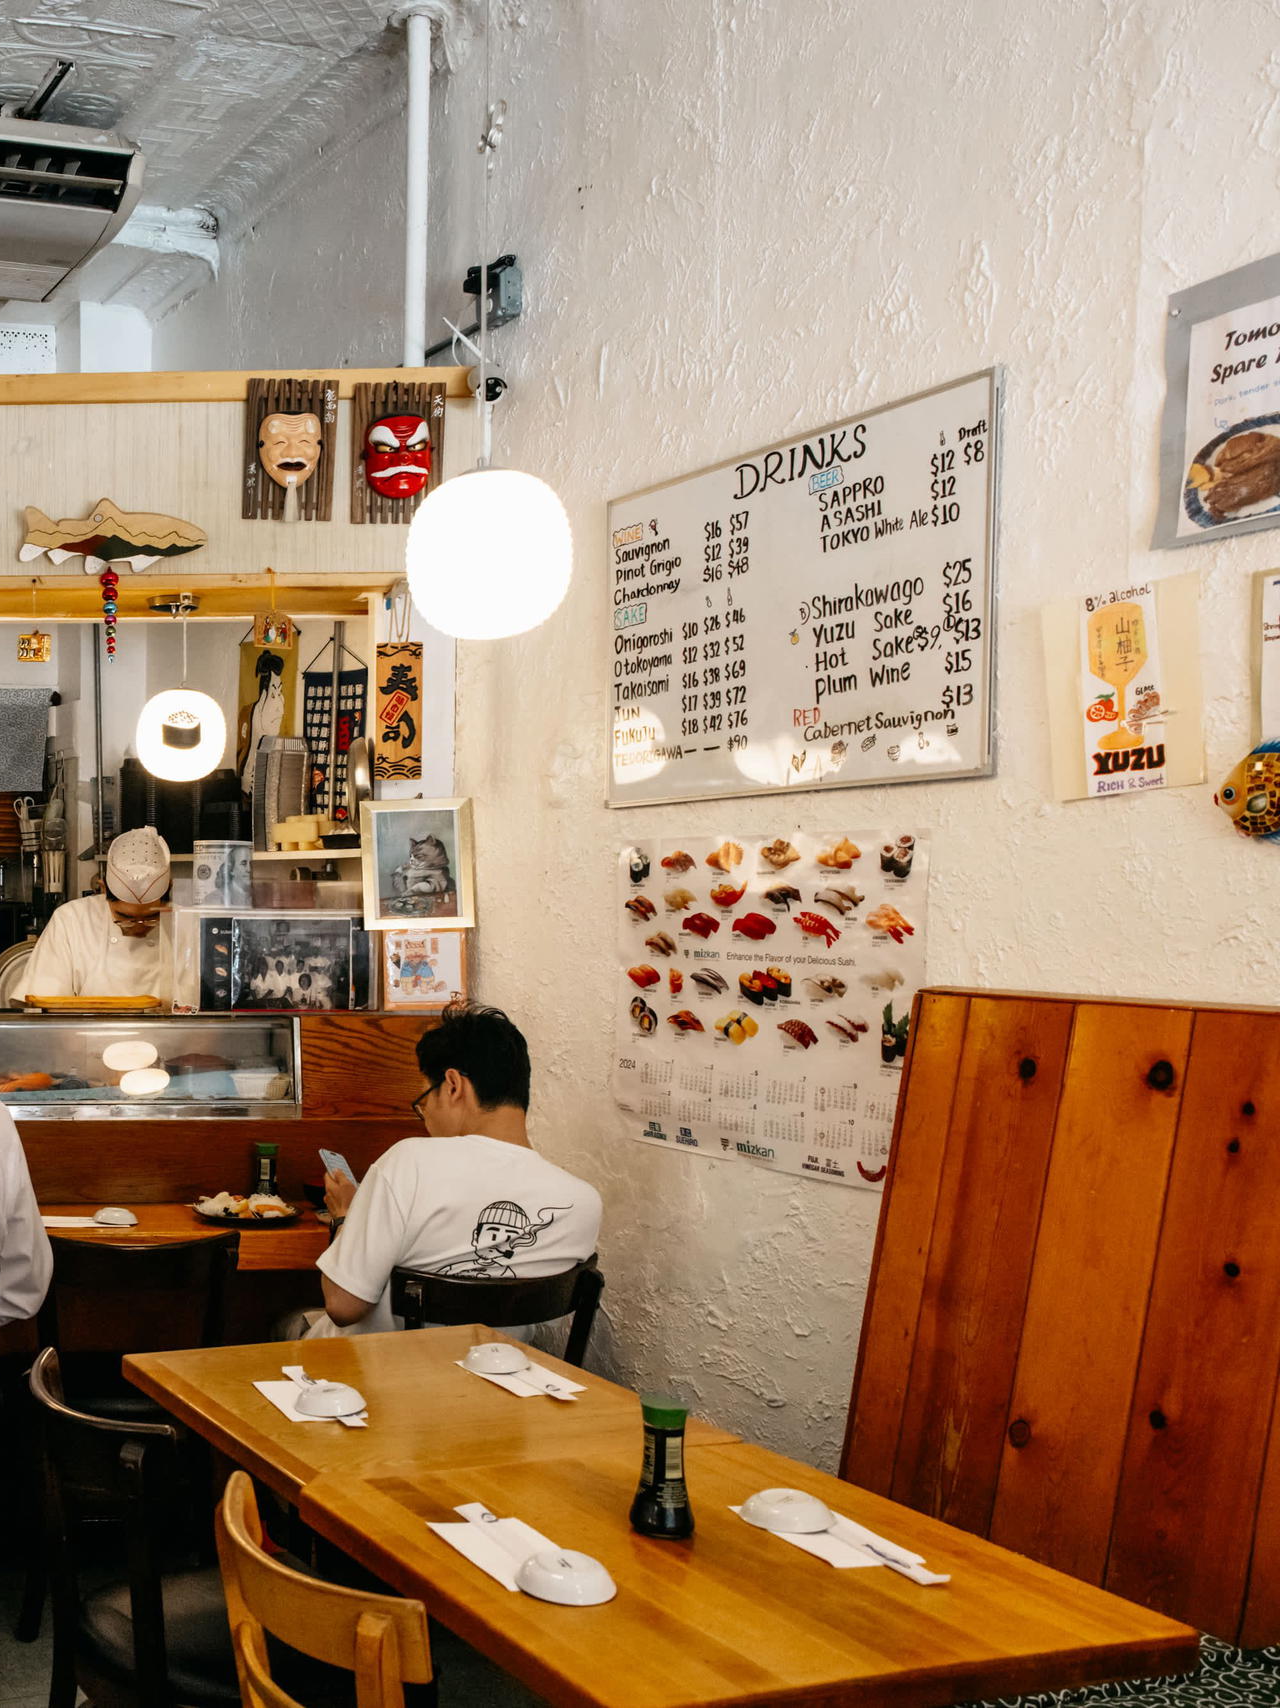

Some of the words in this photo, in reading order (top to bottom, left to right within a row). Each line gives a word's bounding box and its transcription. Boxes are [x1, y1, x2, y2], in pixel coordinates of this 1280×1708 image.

[1210, 354, 1267, 384] Spare
[958, 420, 988, 442] Draft
[733, 424, 867, 499] DRINKS
[812, 469, 840, 490] BEER
[819, 475, 885, 512] SAPPRO
[931, 450, 955, 477] $12
[964, 440, 985, 465] $8
[821, 500, 882, 532] ASASHI
[931, 475, 956, 501] $12
[614, 526, 641, 545] WINE
[615, 538, 670, 565] Sauvignon
[704, 520, 722, 542] $16
[730, 511, 749, 536] $57
[821, 526, 870, 553] TOKYO
[909, 509, 929, 531] Ale
[931, 502, 960, 527] $10
[616, 563, 645, 586] Pinot
[650, 556, 682, 577] Grigio
[704, 543, 722, 563] $12
[729, 536, 749, 559] $39
[614, 578, 681, 606] Chardonnay
[703, 564, 722, 583] $16
[728, 556, 749, 579] $48
[812, 577, 924, 620] Shirakawago
[942, 559, 972, 588] $25
[615, 605, 645, 628] SAKE
[874, 608, 913, 632] Sake
[942, 590, 972, 616] $16
[614, 628, 673, 655] Onigoroshi
[682, 622, 698, 640] $10
[704, 615, 721, 635] $26
[725, 608, 746, 628] $46
[815, 647, 848, 672] Hot
[872, 636, 914, 661] Sake
[954, 618, 981, 644] $13
[614, 653, 672, 678] Otokoyama
[683, 646, 698, 664] $12
[703, 641, 720, 661] $32
[724, 634, 744, 655] $52
[682, 671, 699, 689] $16
[703, 667, 720, 686] $38
[724, 660, 746, 680] $69
[870, 662, 911, 688] Wine
[944, 649, 972, 675] $15
[379, 663, 419, 749] 寿司
[681, 694, 698, 713] $17
[703, 691, 721, 710] $39
[726, 685, 747, 706] $72
[793, 707, 821, 727] RED
[941, 683, 973, 709] $13
[681, 718, 699, 736] $18
[703, 714, 722, 734] $42
[727, 709, 748, 729] $76
[804, 715, 873, 742] Cabernet
[874, 707, 955, 730] Sauvignon
[727, 735, 748, 752] $90
[1091, 744, 1166, 776] YUZU
[693, 948, 720, 959] mizkan
[726, 952, 752, 962] Enhance
[754, 953, 764, 962] the
[765, 953, 783, 963] Flavor
[784, 954, 792, 963] of
[793, 956, 806, 965] your
[807, 955, 836, 966] Delicious
[619, 1058, 636, 1070] 2024
[736, 1140, 775, 1159] mizkan
